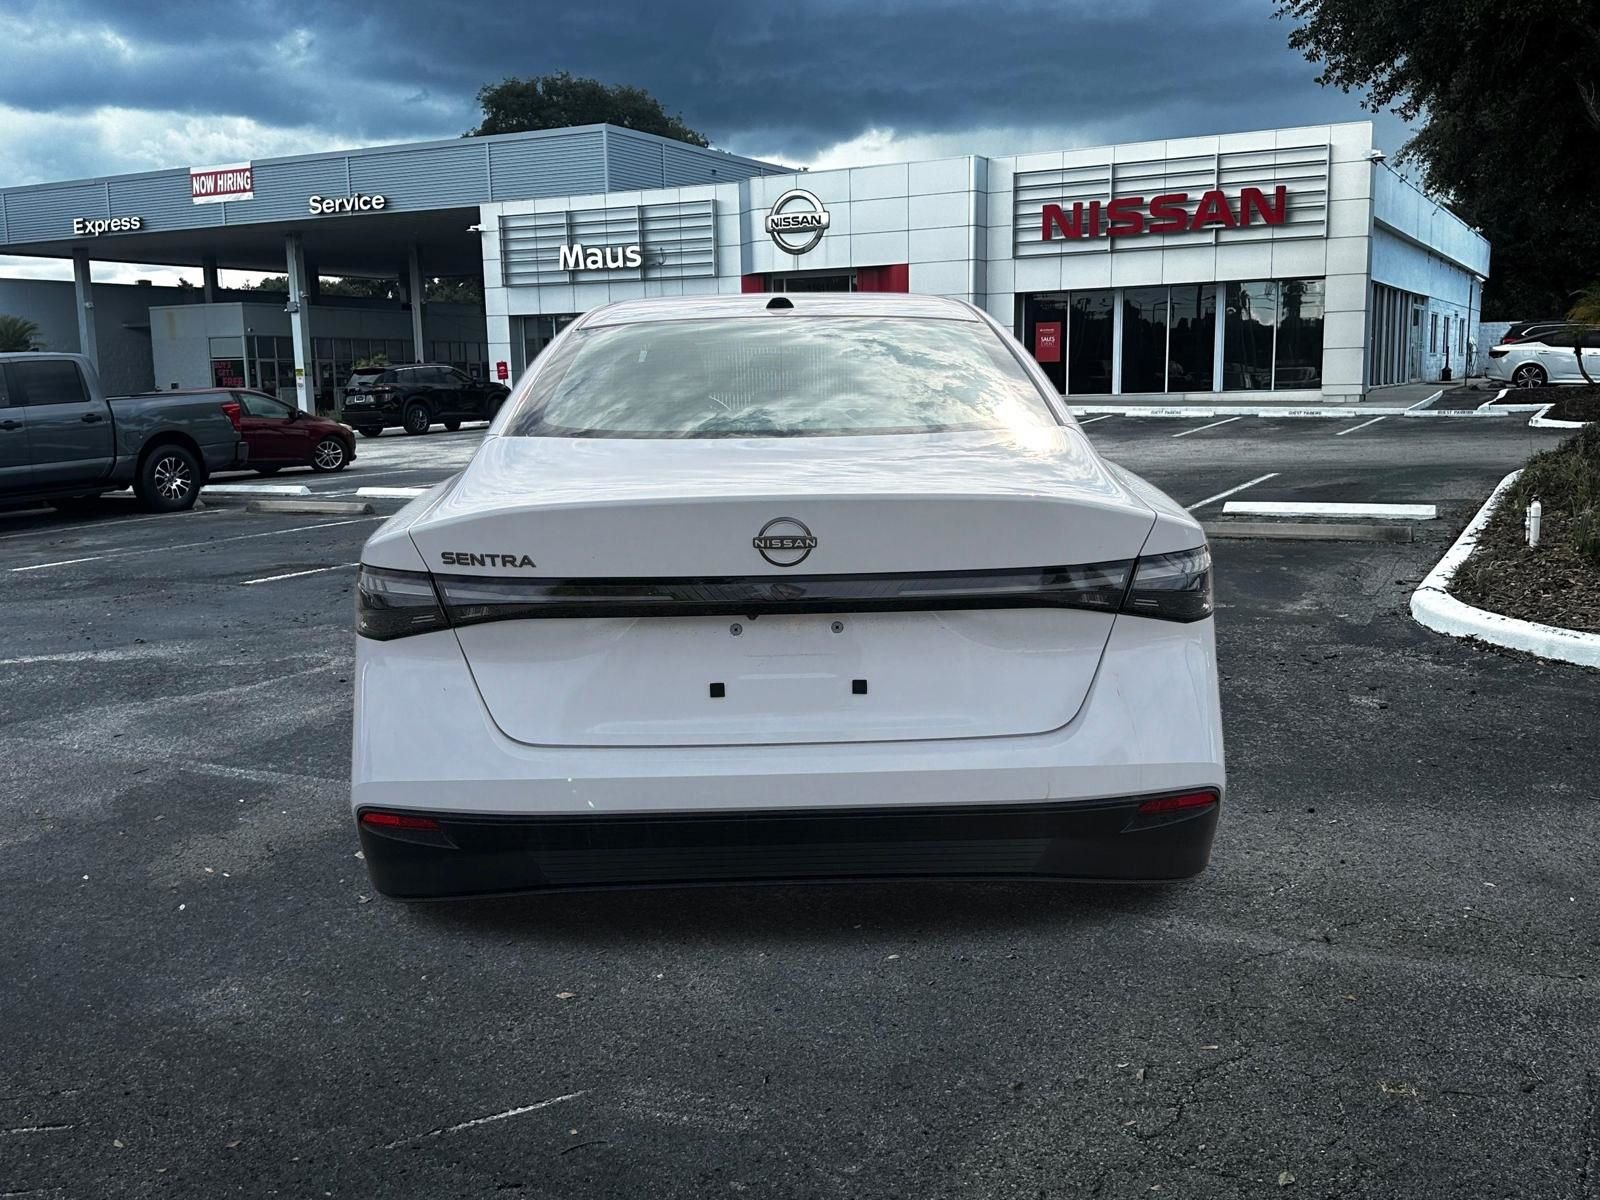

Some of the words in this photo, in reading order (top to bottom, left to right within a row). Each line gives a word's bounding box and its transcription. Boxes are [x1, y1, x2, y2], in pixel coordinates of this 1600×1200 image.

[192, 174, 215, 195] NOW
[217, 170, 251, 192] HIRING
[308, 193, 385, 215] Service
[1041, 184, 1288, 241] NISSAN
[73, 216, 141, 237] Express
[770, 214, 822, 228] NISSAN
[559, 243, 642, 271] Maus
[223, 377, 243, 385] FREE
[754, 539, 816, 548] NISSAN
[441, 551, 536, 568] SENTRA
